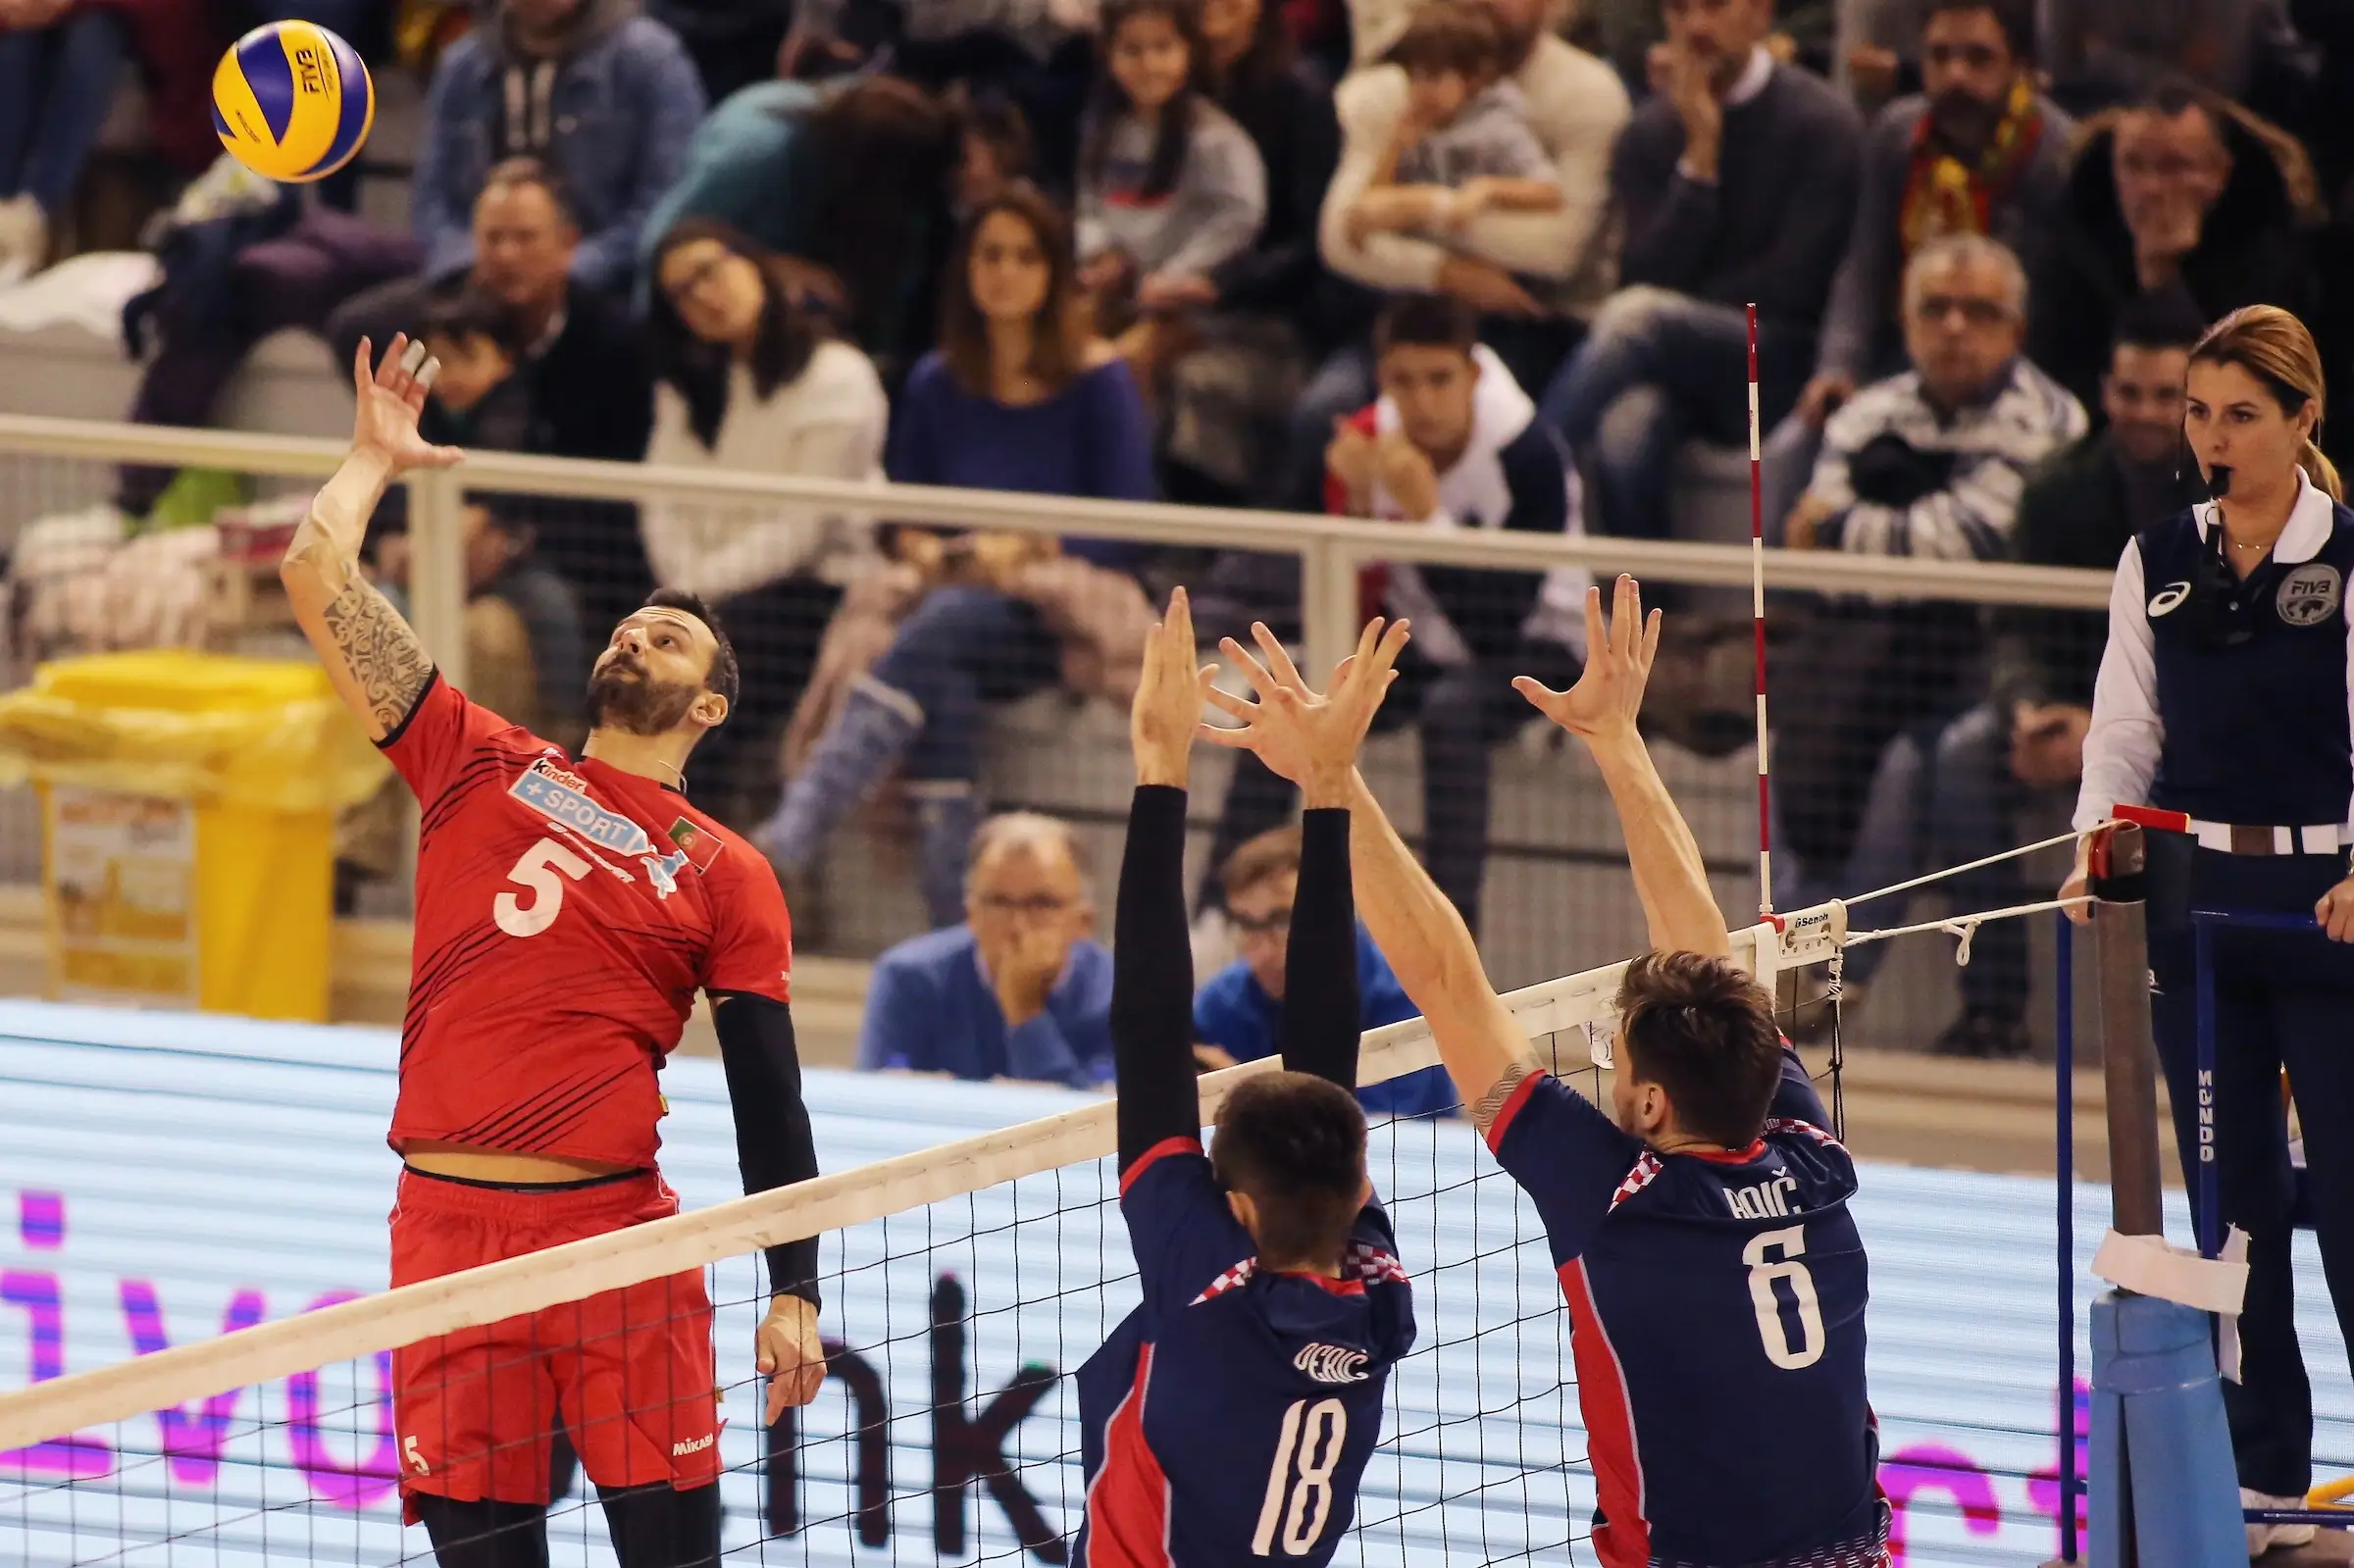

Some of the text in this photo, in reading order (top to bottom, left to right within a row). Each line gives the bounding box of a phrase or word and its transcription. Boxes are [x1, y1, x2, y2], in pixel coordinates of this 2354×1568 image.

[2291, 580, 2331, 594] FIVB
[493, 837, 593, 937] 5
[1742, 1224, 1826, 1370] 6
[404, 1435, 431, 1477] 5
[1252, 1397, 1348, 1556] 18
